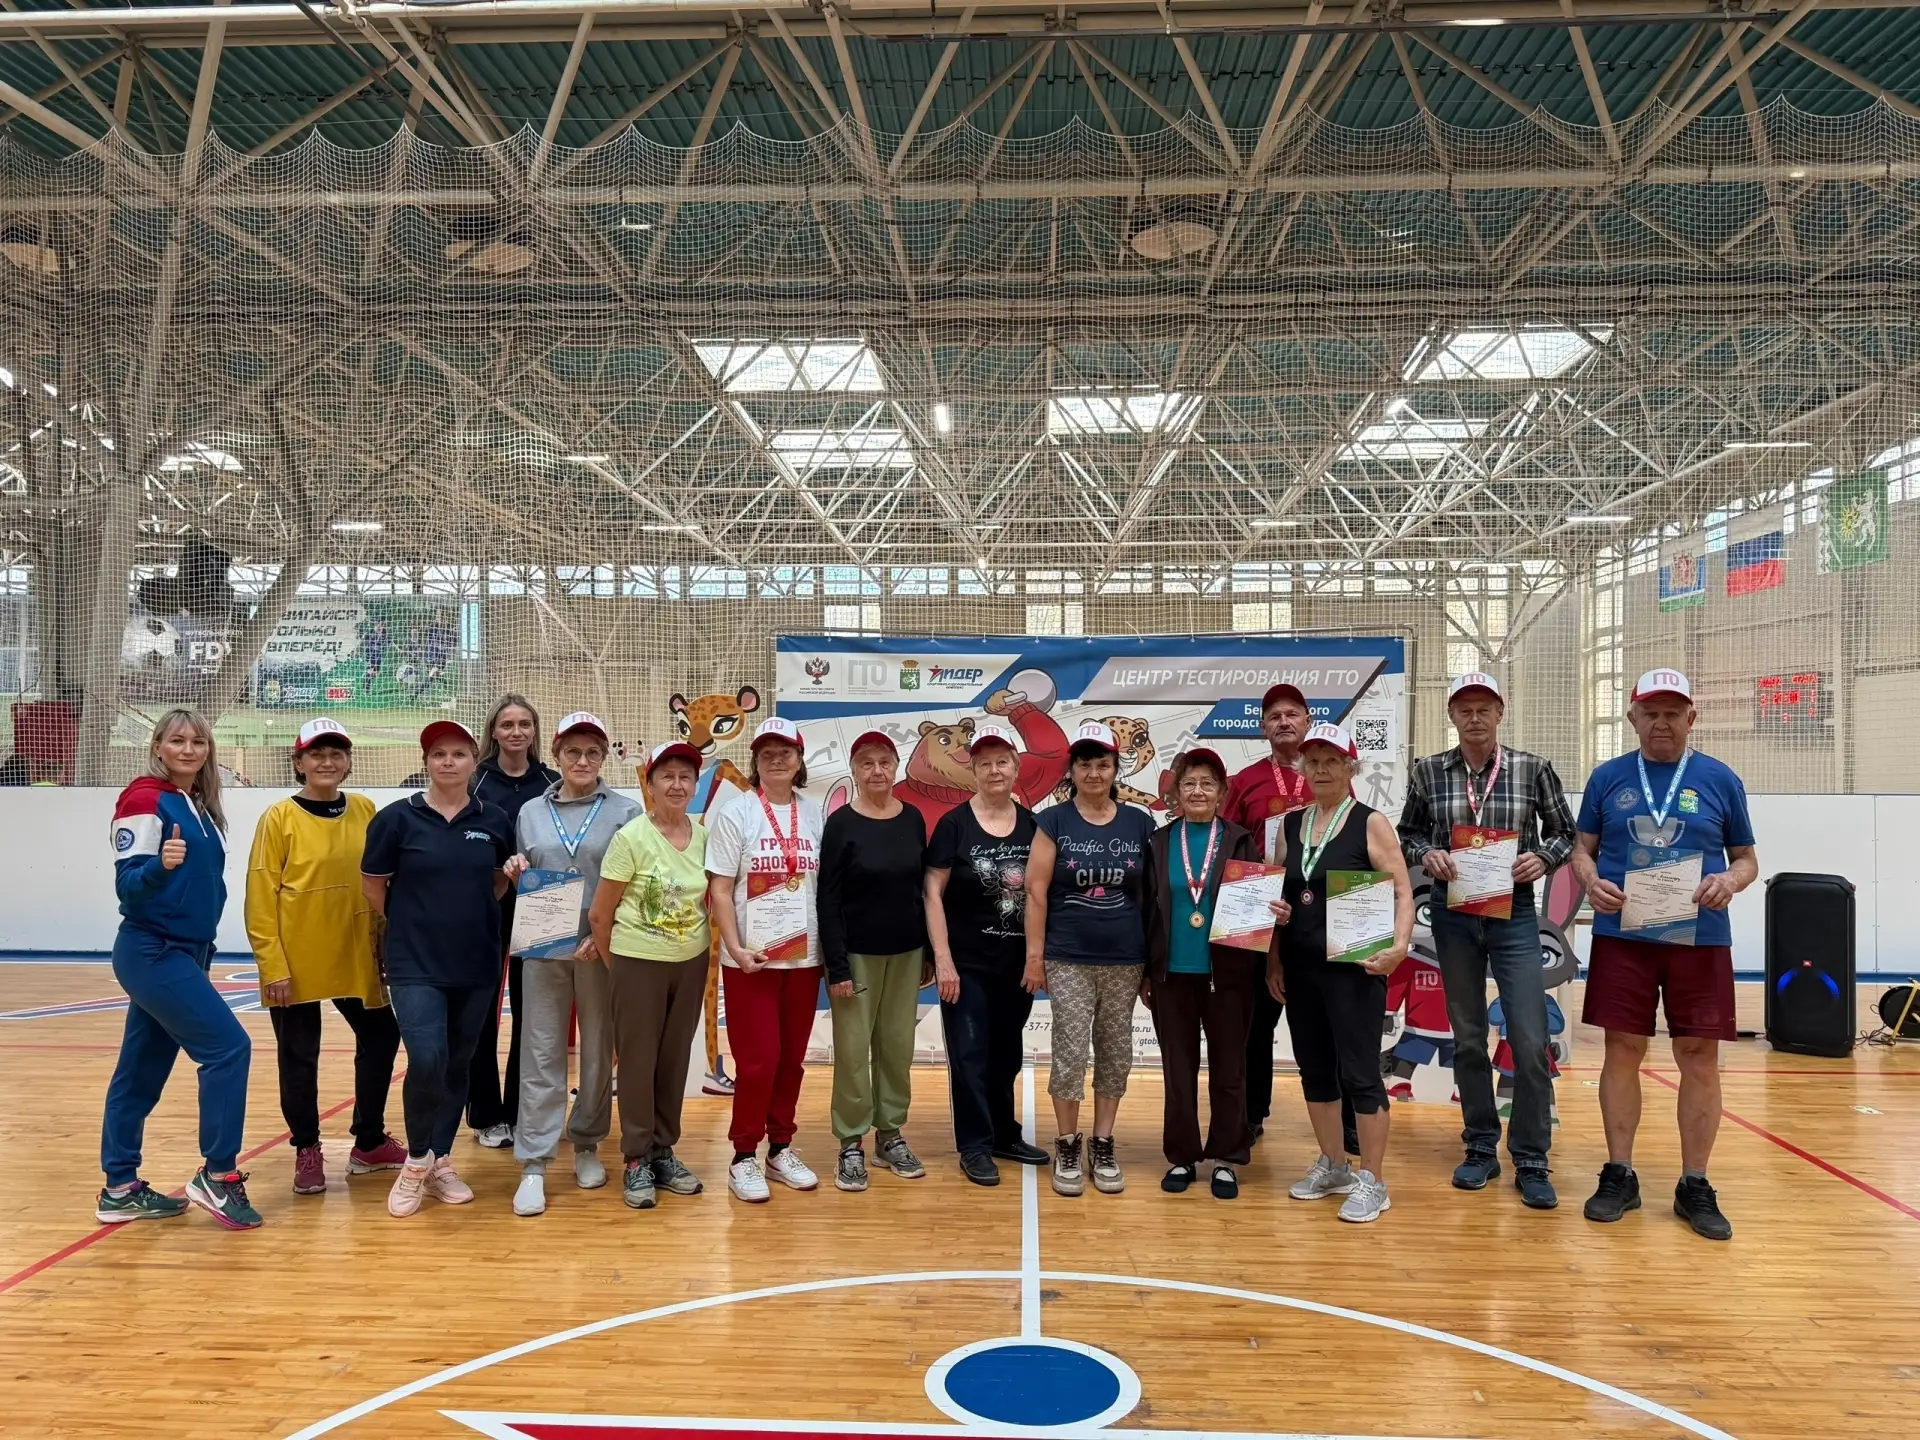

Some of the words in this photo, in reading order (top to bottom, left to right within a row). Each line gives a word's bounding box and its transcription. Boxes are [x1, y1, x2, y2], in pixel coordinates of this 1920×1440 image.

[281, 605, 358, 621] ВИГАЙСЯ
[274, 624, 337, 637] ОЛЬКО
[266, 638, 343, 655] ВПЕРЁД!
[848, 660, 887, 685] ГТО
[928, 665, 983, 682] ЛИДЕР
[1113, 669, 1173, 686] ЦЕНТР
[1176, 669, 1320, 686] ТЕСТИРОВАНИЯ
[1324, 669, 1359, 686] ГТО
[1462, 674, 1485, 684] ГТО
[1653, 672, 1679, 686] ГТО
[313, 719, 338, 732] ГТО
[762, 720, 784, 732] ГТО
[1079, 724, 1101, 737] ГТО
[1314, 724, 1338, 738] ГТО
[760, 837, 814, 851] ГРПА
[1057, 835, 1105, 856] Pacific
[1108, 837, 1141, 857] Girls
[1654, 859, 1677, 867] ГРАМОТА
[1076, 867, 1125, 887] CLUB
[1415, 970, 1438, 986] ГТО
